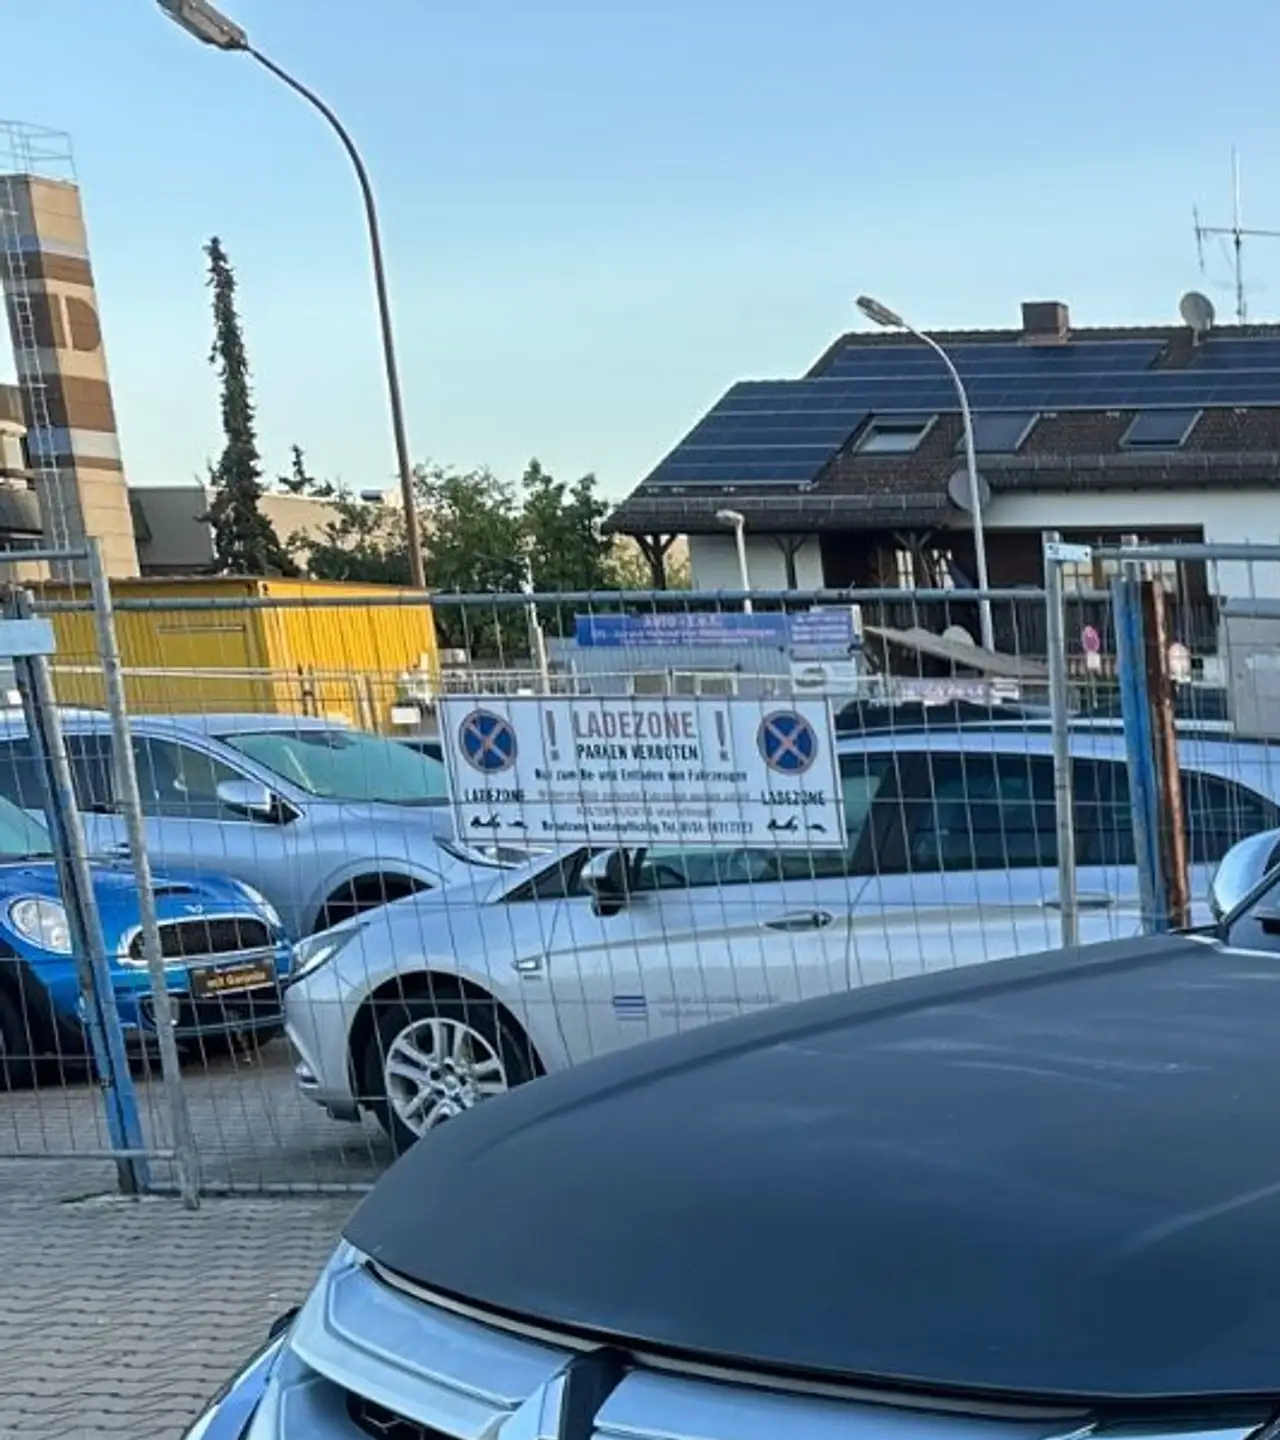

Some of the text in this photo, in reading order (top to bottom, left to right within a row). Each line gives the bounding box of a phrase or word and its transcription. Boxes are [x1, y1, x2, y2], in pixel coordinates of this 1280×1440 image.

[573, 710, 697, 740] LADEZONE
[577, 743, 699, 761] PARKEN VERBOTEN
[464, 788, 526, 804] LADEZONE
[761, 789, 826, 805] LADEZONE
